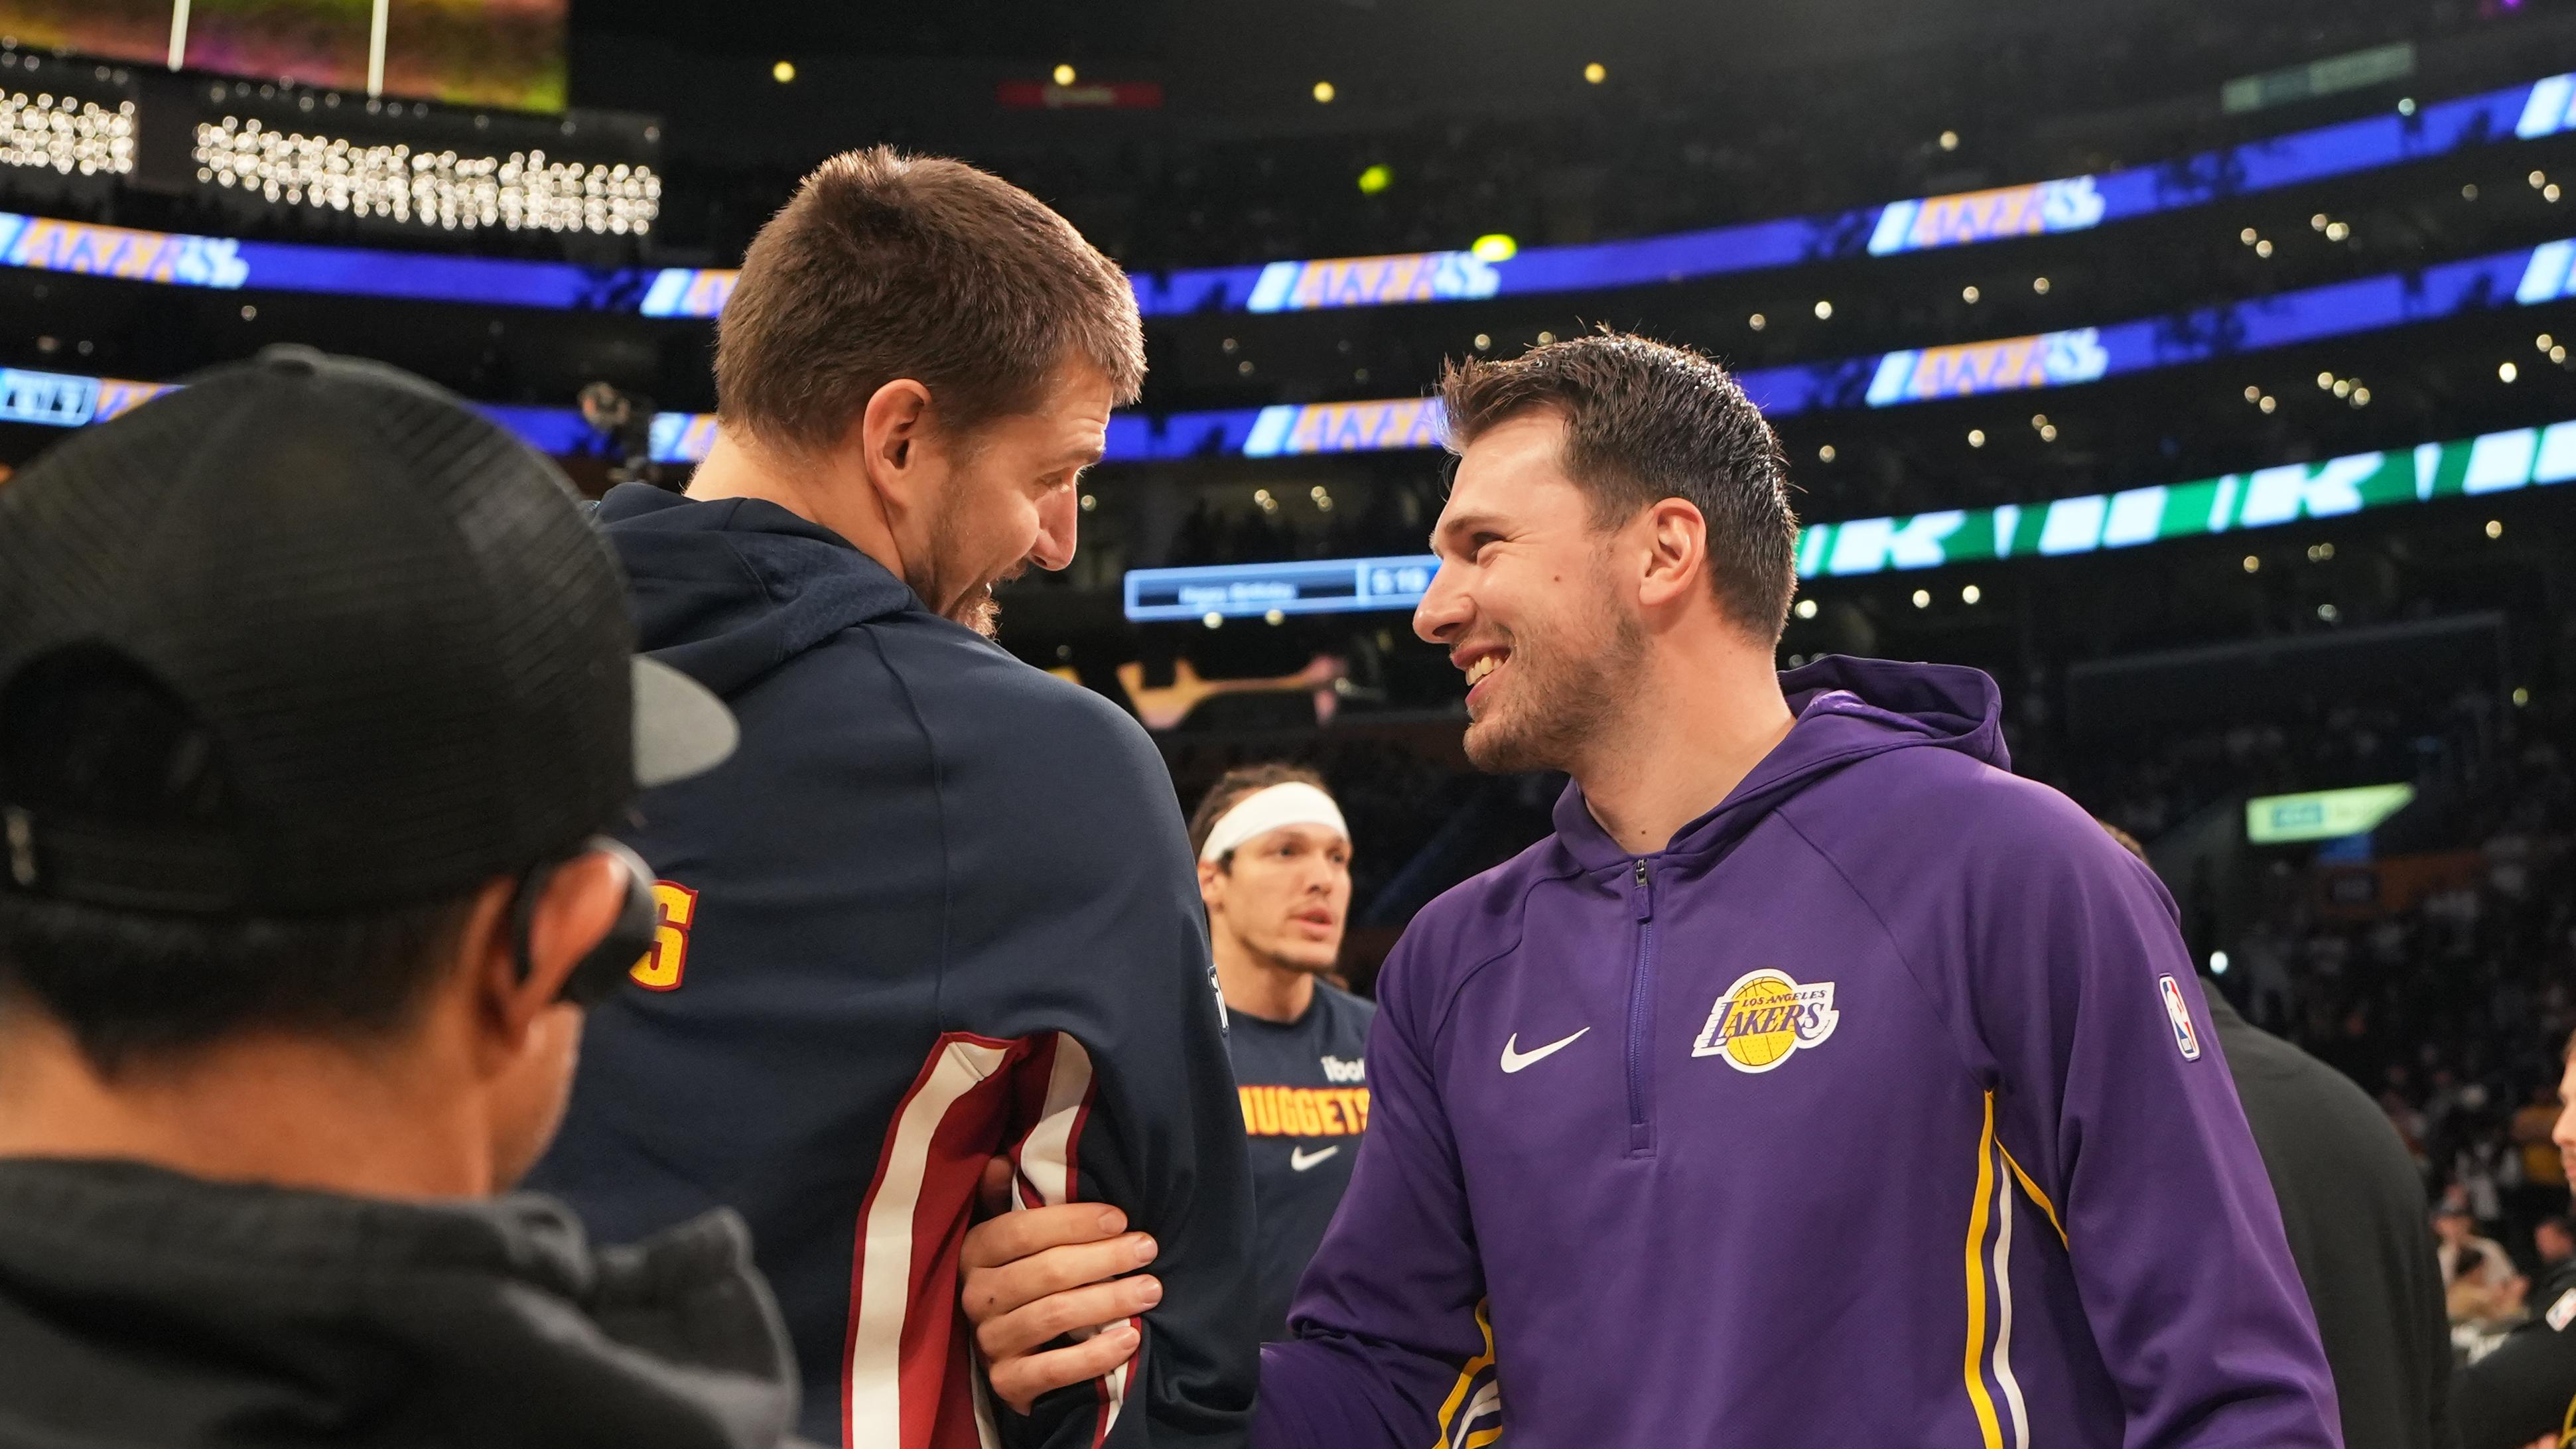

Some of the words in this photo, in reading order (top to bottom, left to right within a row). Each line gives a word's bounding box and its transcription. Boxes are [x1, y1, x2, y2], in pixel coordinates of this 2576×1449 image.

[1741, 997, 1765, 1008] LOS
[1765, 989, 1828, 1004] ANGELES
[1701, 1000, 1830, 1049] LAKERS
